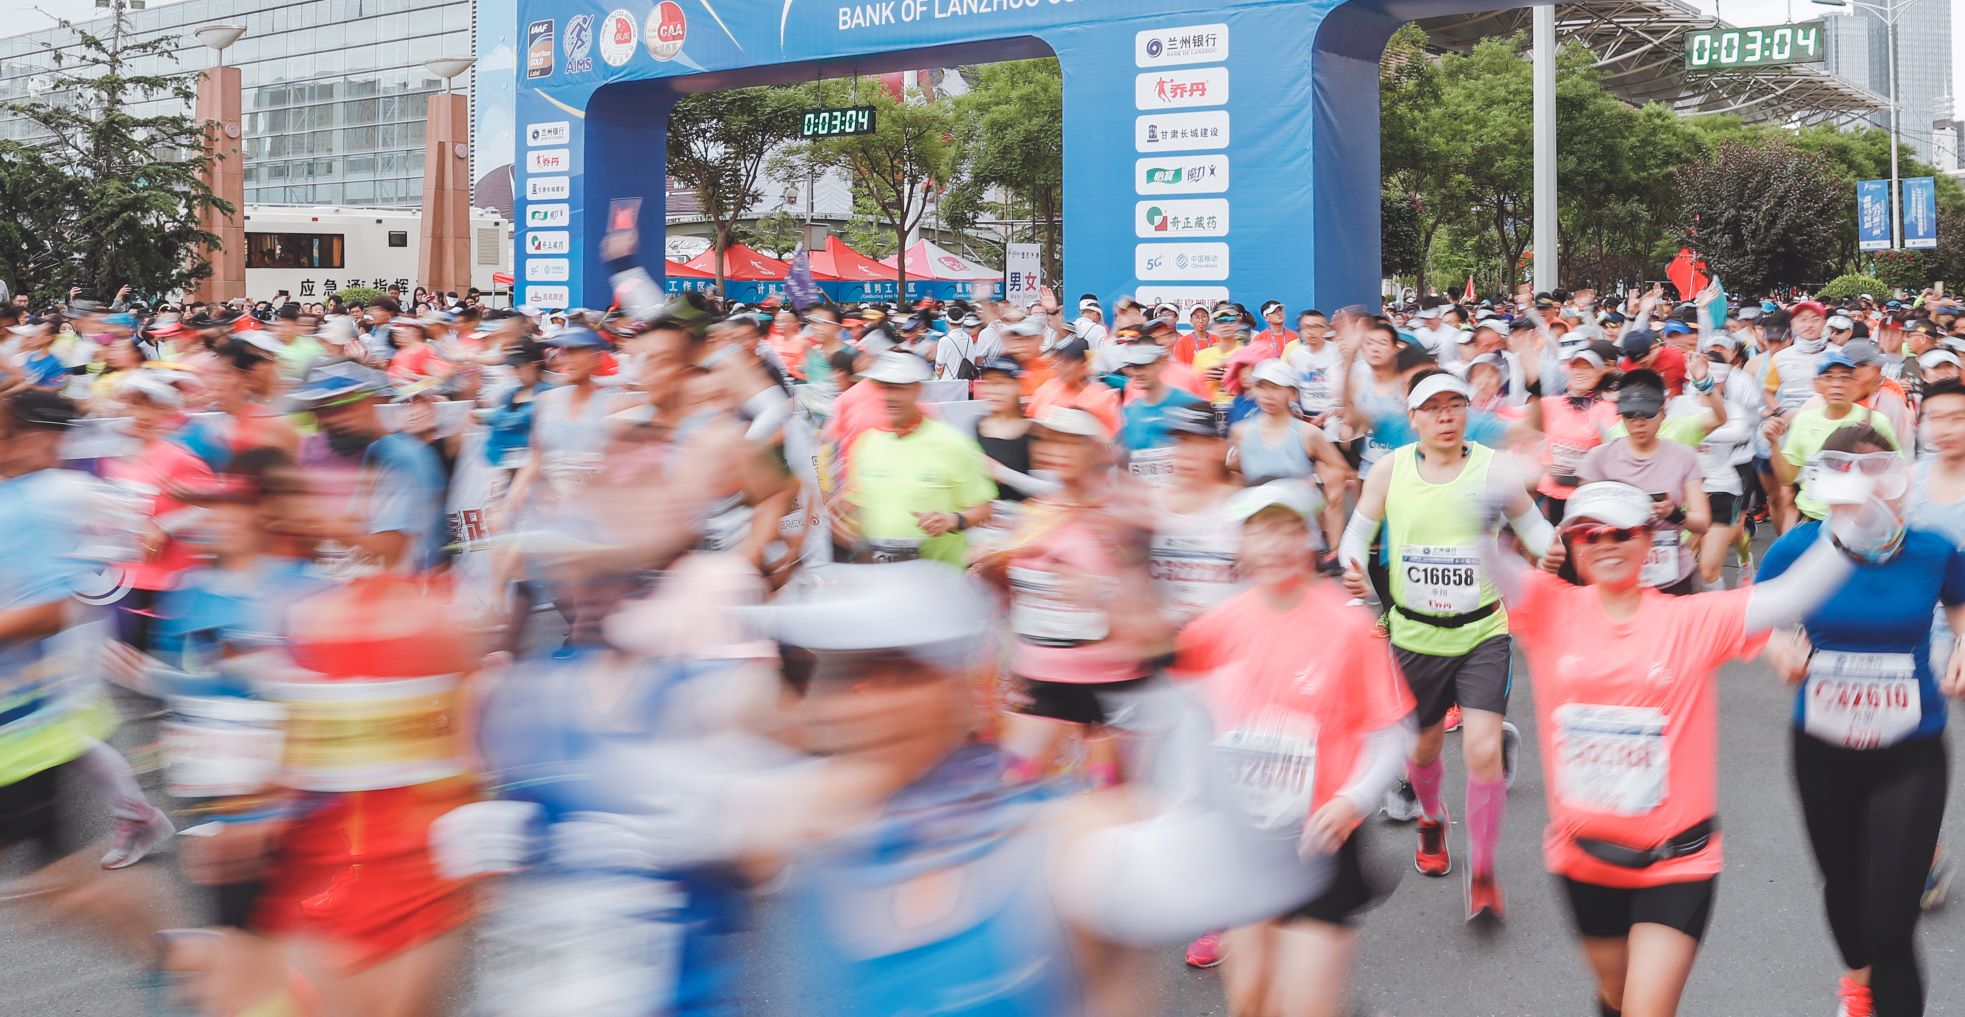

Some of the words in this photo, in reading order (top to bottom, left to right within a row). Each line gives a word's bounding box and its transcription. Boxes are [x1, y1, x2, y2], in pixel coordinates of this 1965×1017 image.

[838, 2, 895, 30] BANK
[901, 0, 928, 22] OF
[531, 24, 548, 34] IAAF
[660, 24, 683, 37] CAA
[1167, 33, 1217, 50] 兰州银行
[1692, 27, 1816, 65] 0:03:04
[566, 58, 592, 73] AIMS
[1170, 82, 1207, 98] 乔丹
[803, 110, 869, 136] 0:03:04
[1160, 127, 1219, 140] 甘肃长城建设
[1170, 215, 1217, 230] 奇正藏药
[864, 282, 915, 293] 裁判工区
[956, 283, 1001, 293] 裁判区
[1010, 272, 1021, 291] 男
[1025, 272, 1037, 291] 女
[1407, 566, 1475, 587] C16658
